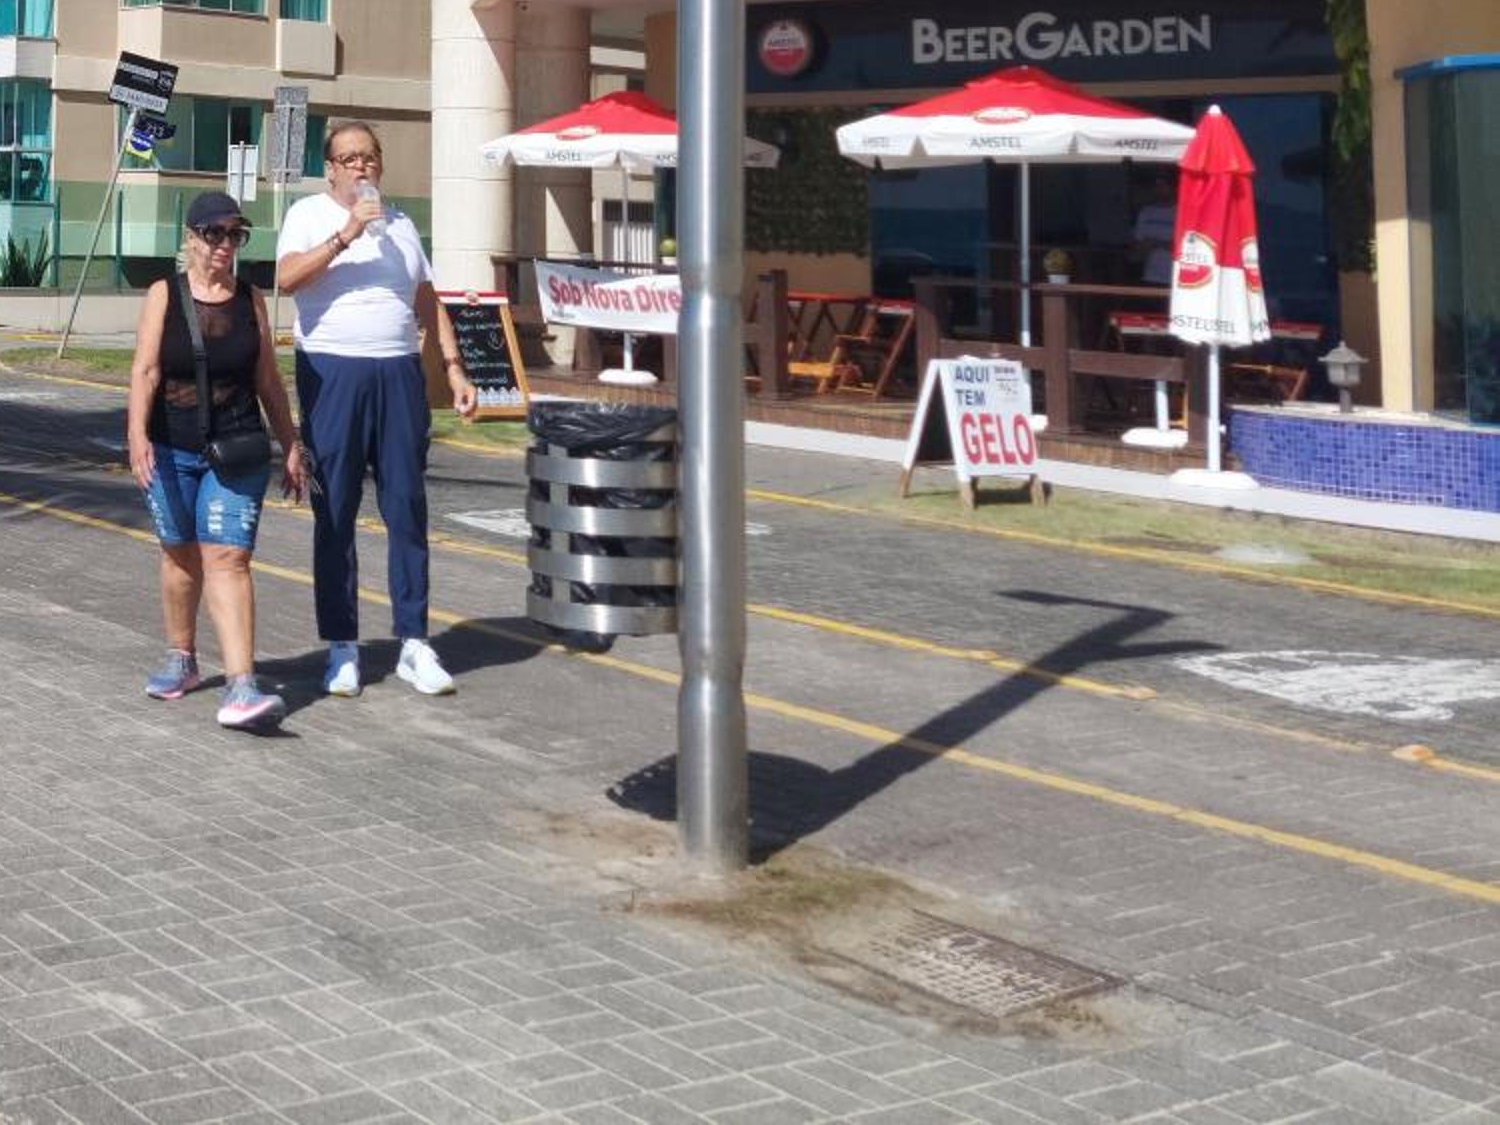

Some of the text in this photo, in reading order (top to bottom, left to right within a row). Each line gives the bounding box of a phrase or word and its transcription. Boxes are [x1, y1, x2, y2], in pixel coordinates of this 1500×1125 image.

[970, 136, 1022, 149] AMSTEL
[548, 275, 582, 305] Sob
[585, 278, 633, 312] Nova
[955, 366, 989, 383] AQUI
[956, 389, 986, 406] TEM
[961, 412, 1035, 466] GELO
